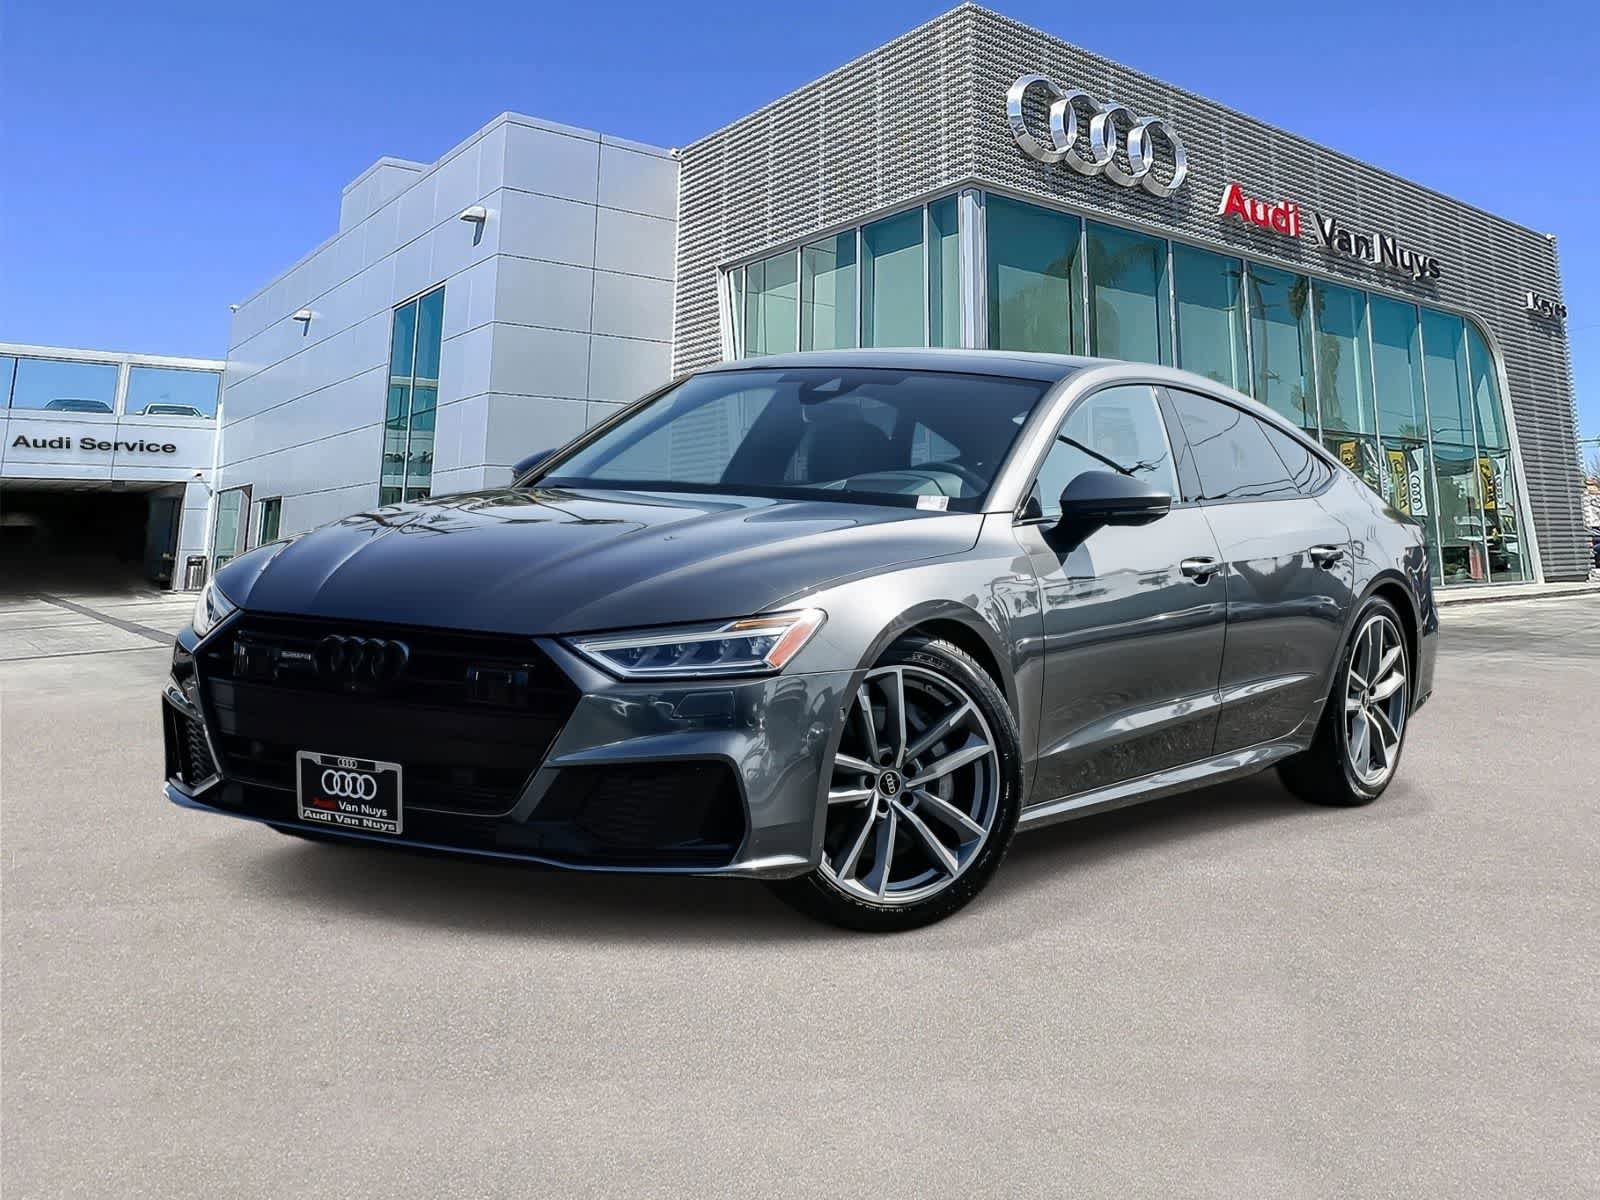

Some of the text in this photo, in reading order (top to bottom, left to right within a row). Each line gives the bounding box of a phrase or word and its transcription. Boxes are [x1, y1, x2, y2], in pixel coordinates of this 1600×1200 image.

[1219, 182, 1442, 281] Audi Van Nuys
[1527, 291, 1568, 319] Keyes
[12, 435, 177, 454] Audi Service
[338, 800, 359, 813] Van
[361, 804, 388, 817] Nuys
[304, 810, 395, 831] Audi Van Nuys
